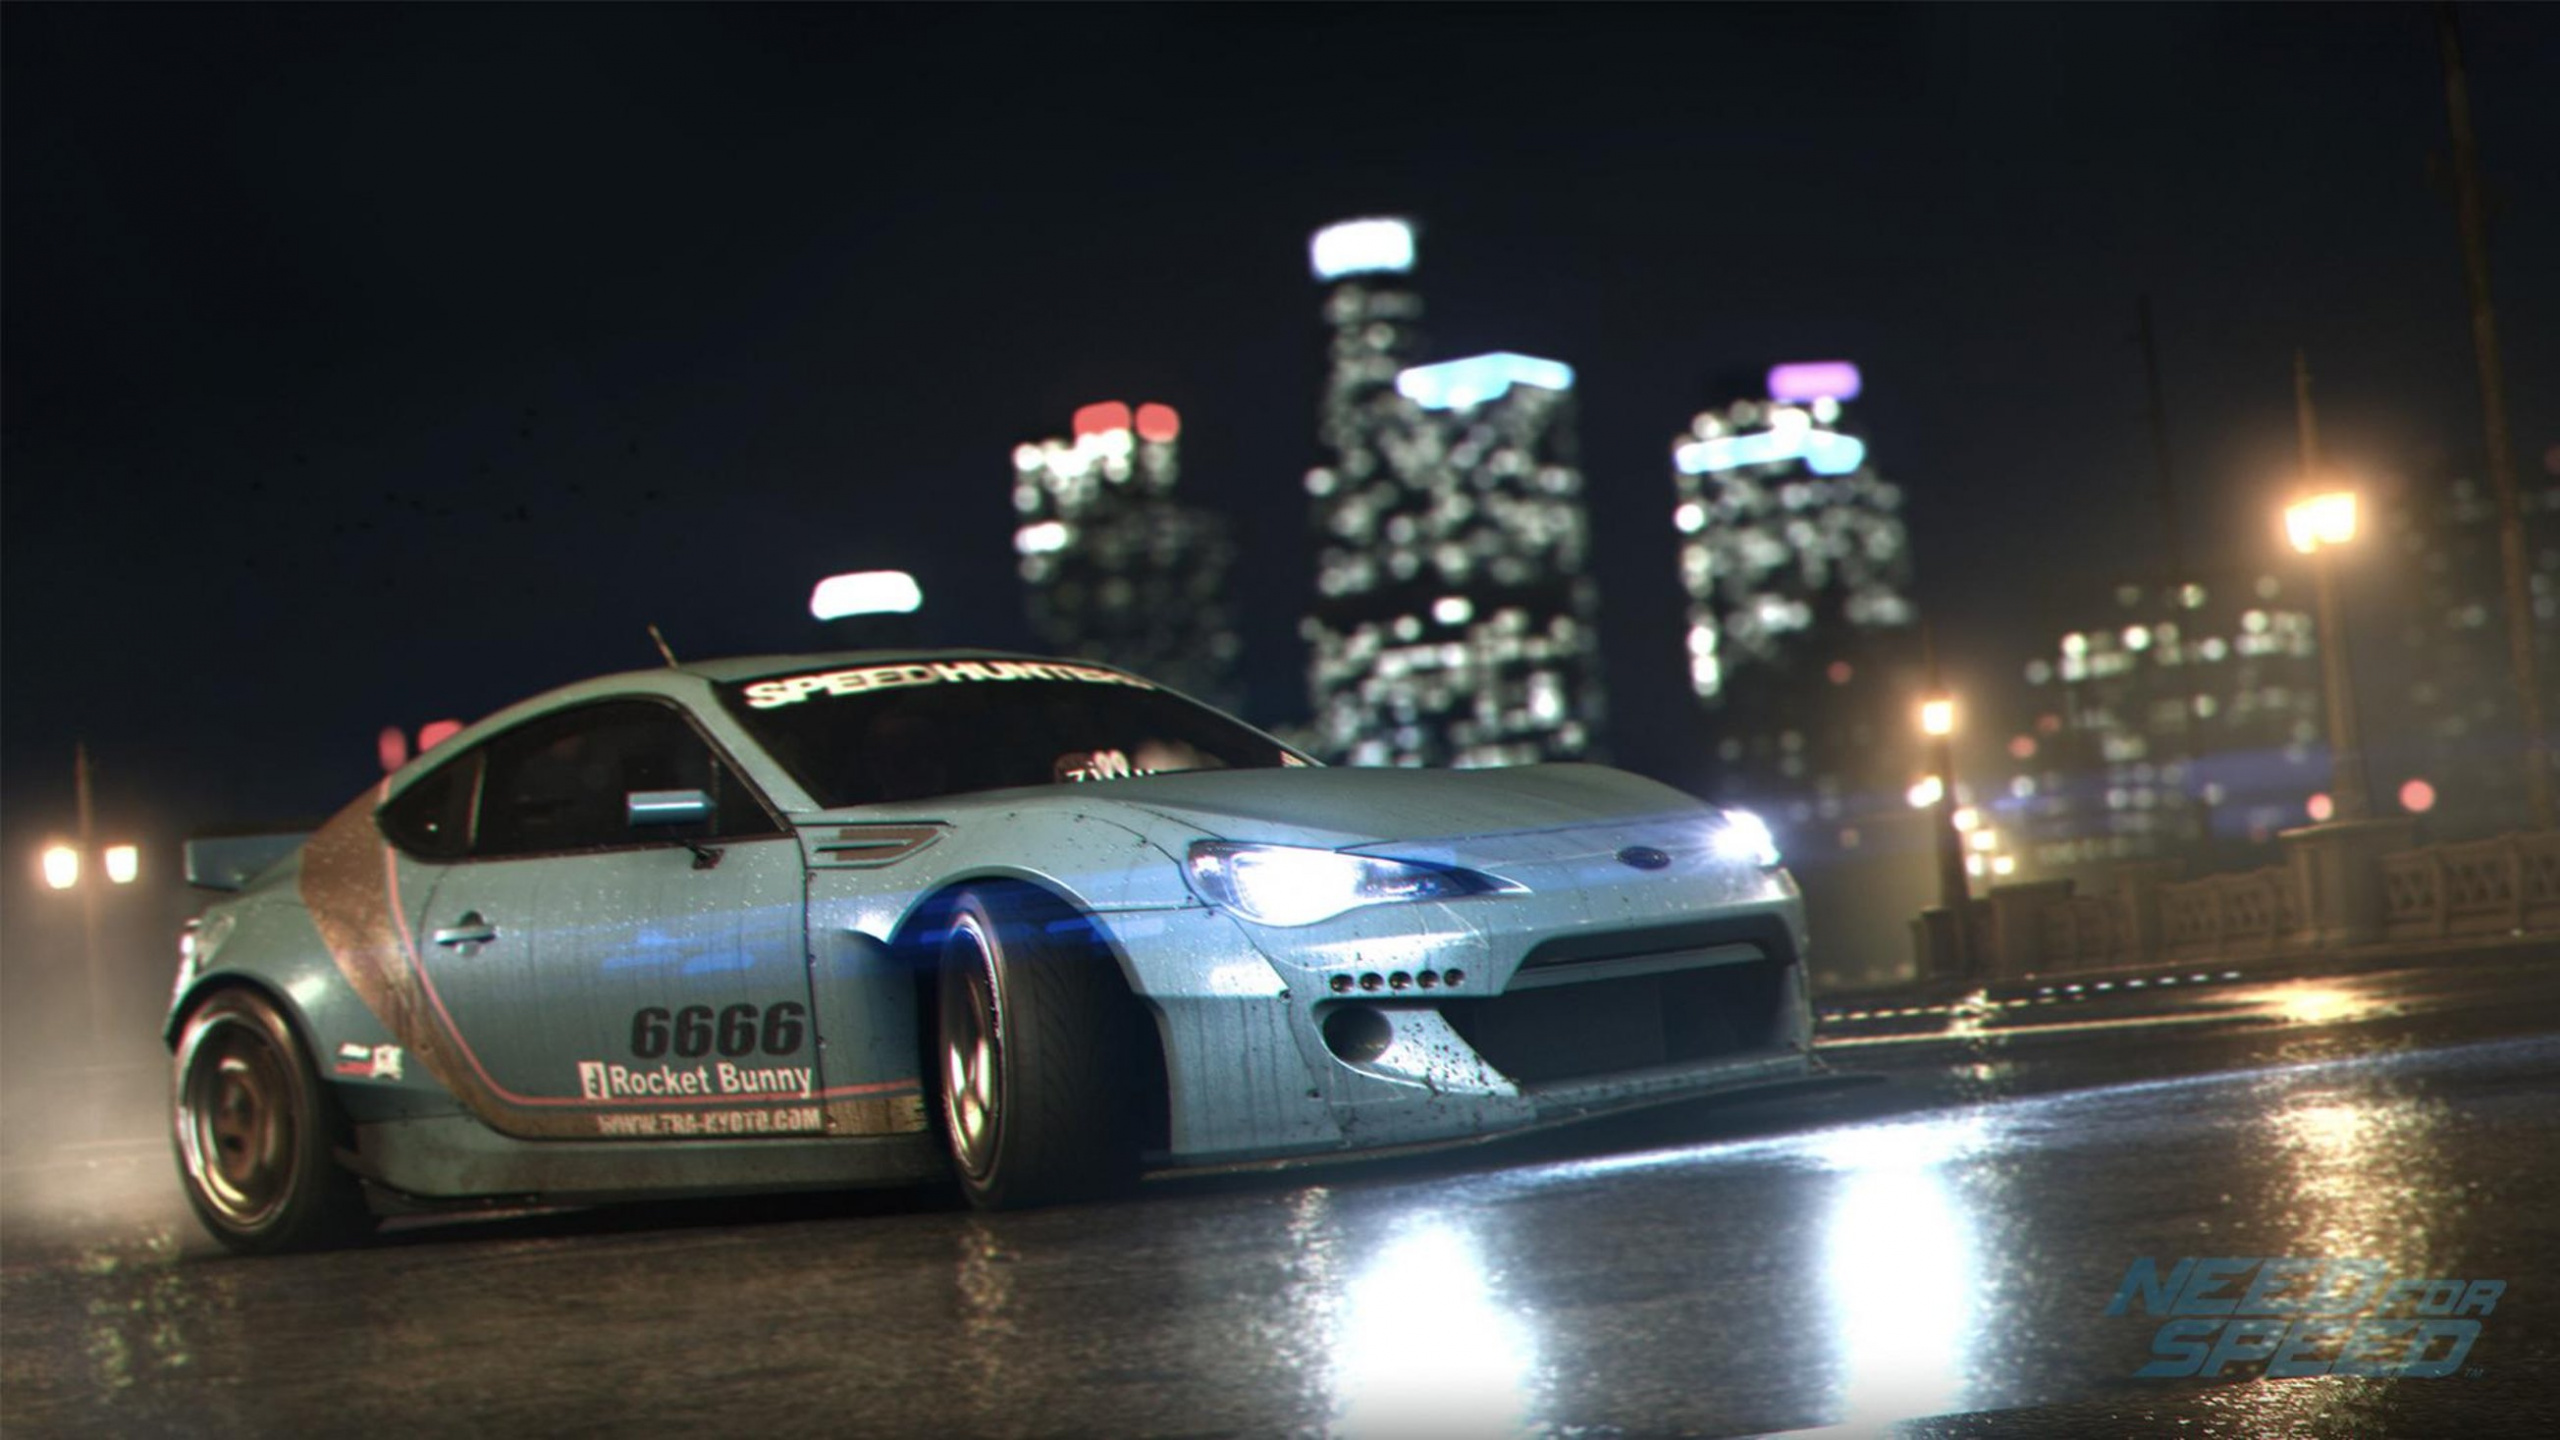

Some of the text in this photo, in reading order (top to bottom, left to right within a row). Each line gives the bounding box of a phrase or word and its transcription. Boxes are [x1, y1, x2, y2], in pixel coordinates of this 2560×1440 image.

[630, 1002, 806, 1060] 6666
[608, 1061, 813, 1099] Rocket Bunny
